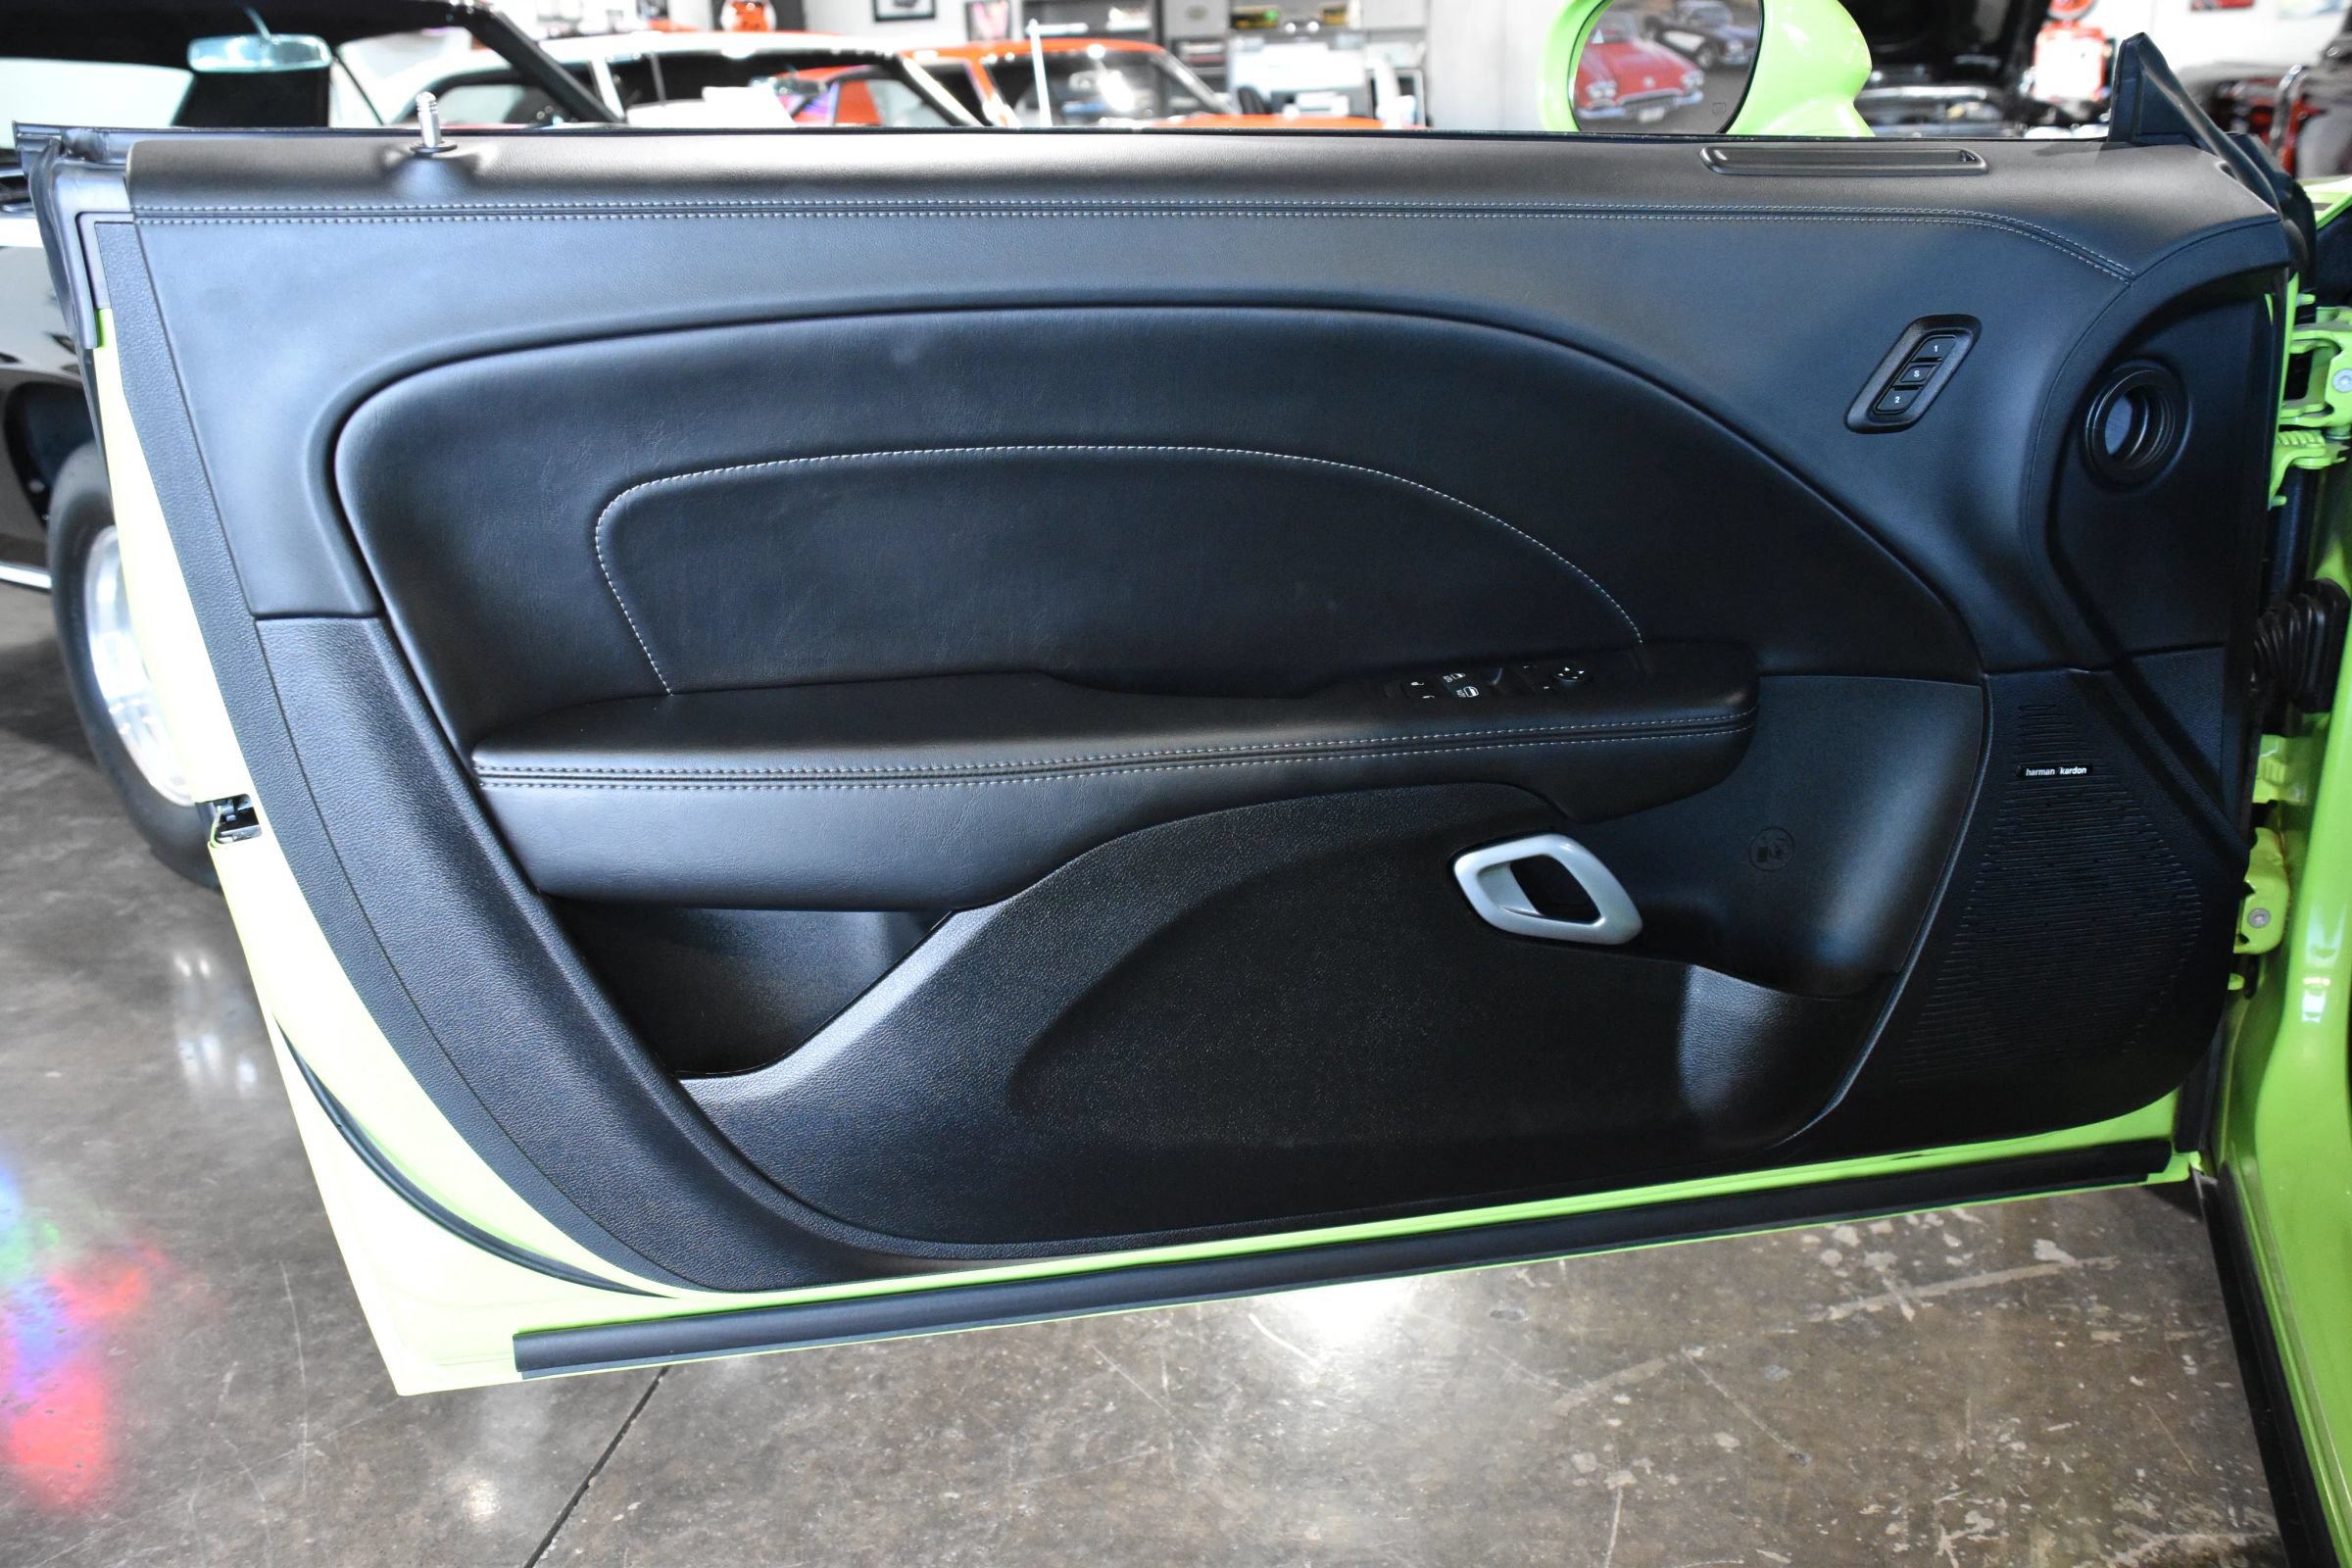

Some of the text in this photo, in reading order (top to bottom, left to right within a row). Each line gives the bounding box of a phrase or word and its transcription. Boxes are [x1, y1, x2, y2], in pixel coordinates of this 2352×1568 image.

[1894, 395, 1901, 404] 2
[2025, 765, 2087, 777] harman kardon
